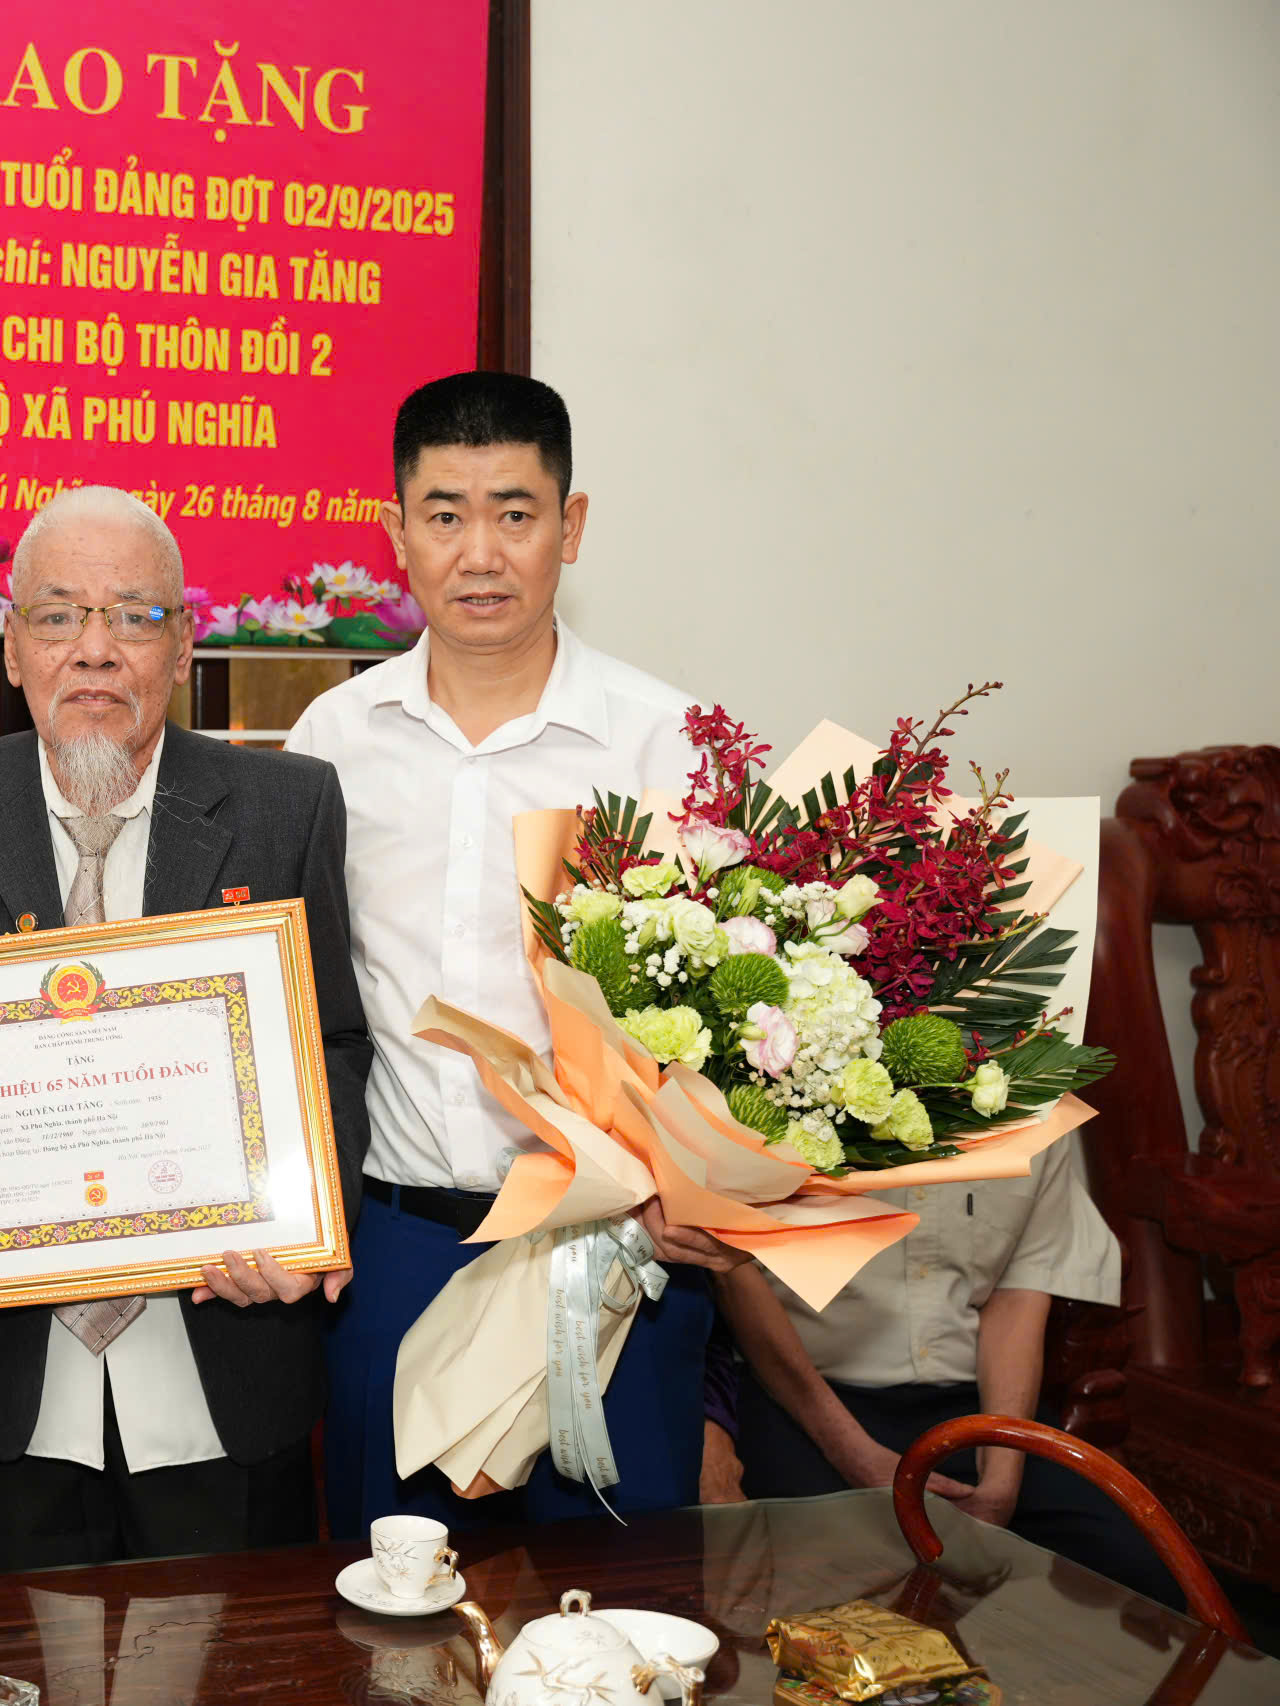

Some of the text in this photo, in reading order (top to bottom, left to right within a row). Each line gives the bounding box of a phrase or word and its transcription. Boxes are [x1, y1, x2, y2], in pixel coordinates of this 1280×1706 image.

[146, 39, 370, 143] TẶNG
[0, 147, 84, 212] TUỔI
[93, 155, 195, 219] ĐẢNG
[205, 174, 274, 229] ĐỢT
[283, 182, 456, 236] 02/9/2025
[61, 232, 208, 296] NGUYỄN
[219, 252, 280, 299] GIA
[289, 249, 382, 305] TĂNG
[1, 315, 64, 363] CHI
[76, 312, 125, 377] BỘ
[135, 316, 230, 372] THÔN
[240, 316, 301, 375] ĐỒI
[310, 333, 333, 377] 2
[21, 386, 72, 440] XÃ
[83, 390, 157, 444] PHÚ
[167, 395, 278, 449] NGHĨA
[180, 484, 216, 517] 26
[221, 486, 297, 529] tháng
[302, 488, 321, 521] 8
[325, 488, 382, 523] năm
[0, 1079, 42, 1099] HIỆU
[46, 1078, 64, 1092] 65
[67, 1072, 108, 1090] NĂM
[111, 1063, 154, 1084] TUỔI
[159, 1061, 209, 1079] ĐẢNG
[56, 1102, 75, 1113] GIA
[76, 1100, 104, 1111] TĂNG
[554, 1288, 566, 1309] best
[575, 1320, 587, 1340] best
